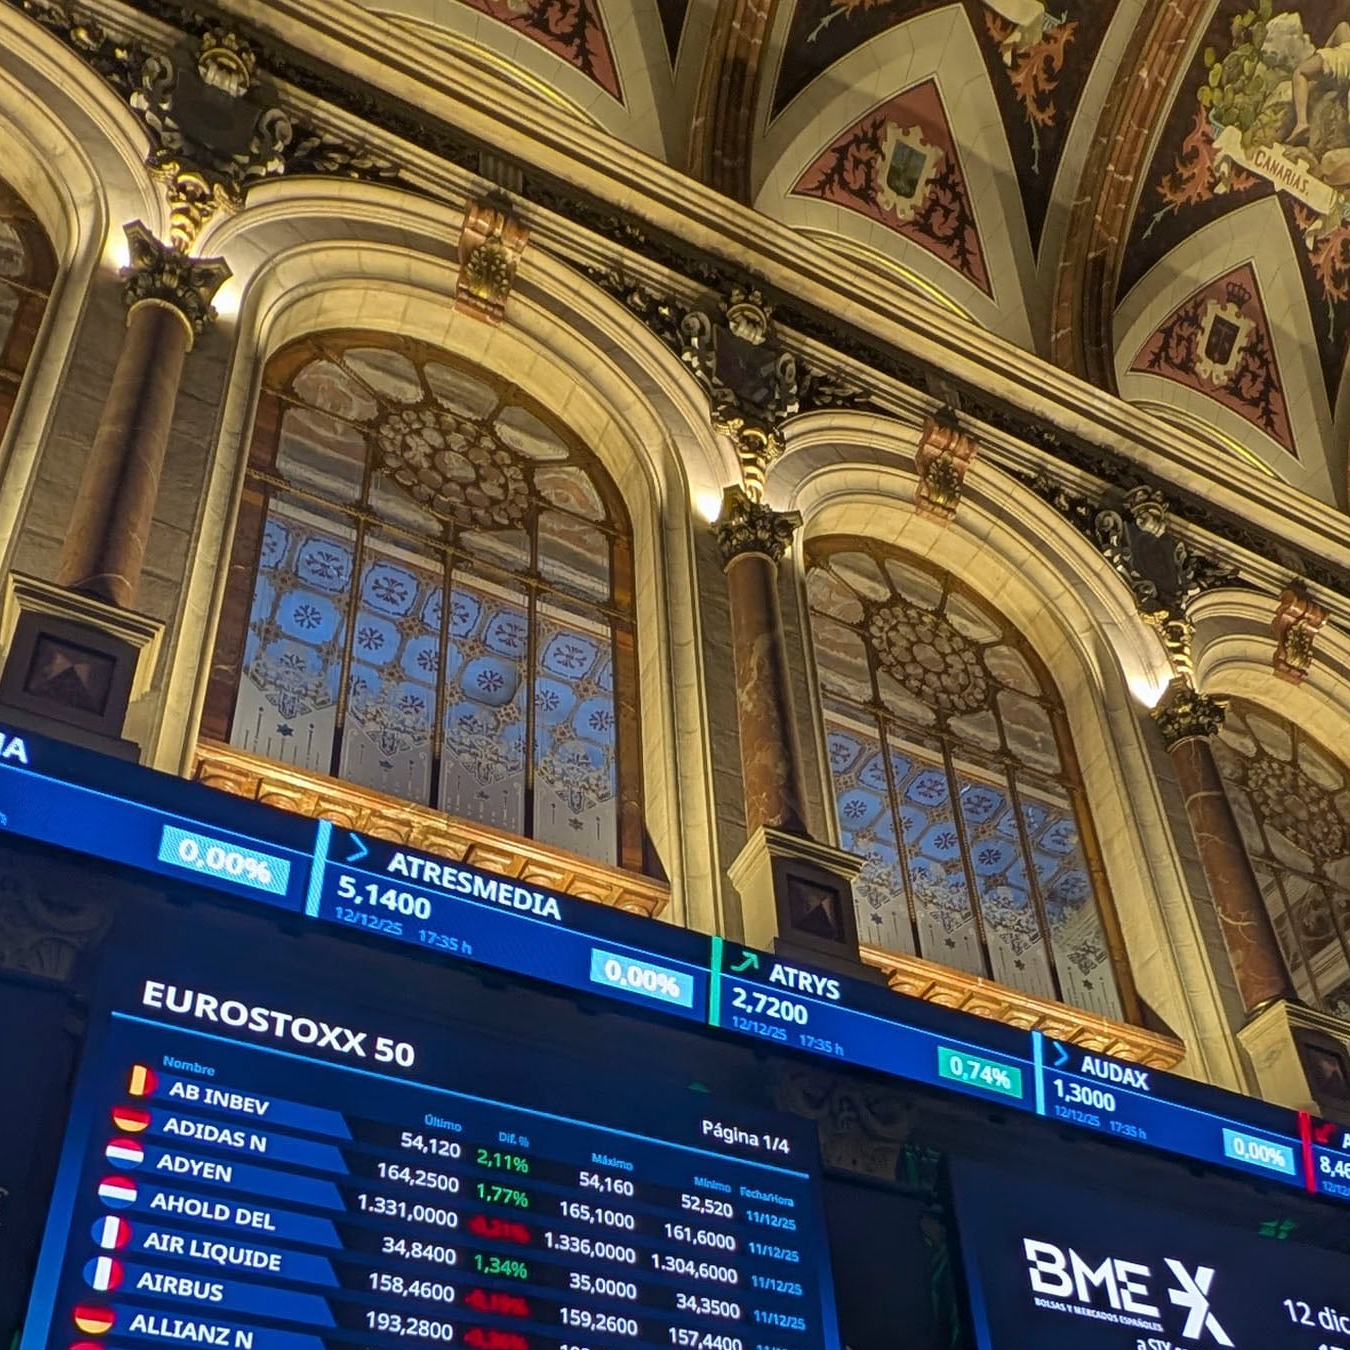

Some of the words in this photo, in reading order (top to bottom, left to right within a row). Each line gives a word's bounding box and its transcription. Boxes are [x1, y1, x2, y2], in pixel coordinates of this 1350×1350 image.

[178, 838, 272, 885] 0,00%
[338, 875, 431, 919] 5,1400
[388, 853, 561, 920] ATRESMEDIA
[604, 958, 680, 998] 0,00%
[770, 964, 840, 999] ATRYS
[733, 987, 808, 1024] 2,7200
[143, 981, 366, 1056] EUROSTOXX
[375, 1037, 414, 1067] 50
[163, 1056, 215, 1076] Nombre
[949, 1057, 1010, 1089] 0,74%
[1082, 1056, 1149, 1090] AUDAX
[1054, 1079, 1115, 1111] 1,3000
[163, 1118, 245, 1147] ADIDAS
[250, 1135, 266, 1152] N
[169, 1082, 199, 1100] AB
[204, 1089, 269, 1115] INBEV
[402, 1132, 461, 1158] 54,120
[477, 1149, 528, 1173] 2,11%
[580, 1172, 634, 1196] 54,160
[682, 1194, 733, 1218] 52,520
[703, 1120, 759, 1146] Página
[764, 1135, 789, 1153] 1/4
[157, 1154, 232, 1182] ADYEN
[1233, 1138, 1285, 1167] 0,00%
[150, 1193, 230, 1220] AHOLD
[236, 1208, 275, 1230] DEL
[143, 1233, 184, 1254] AIR
[190, 1240, 281, 1271] LIQUIDE
[137, 1273, 223, 1301] AIRBUS
[1024, 1238, 1160, 1317] BME
[1284, 1299, 1315, 1326] 12
[129, 1315, 230, 1345] ALLIANZ
[235, 1331, 253, 1349] N
